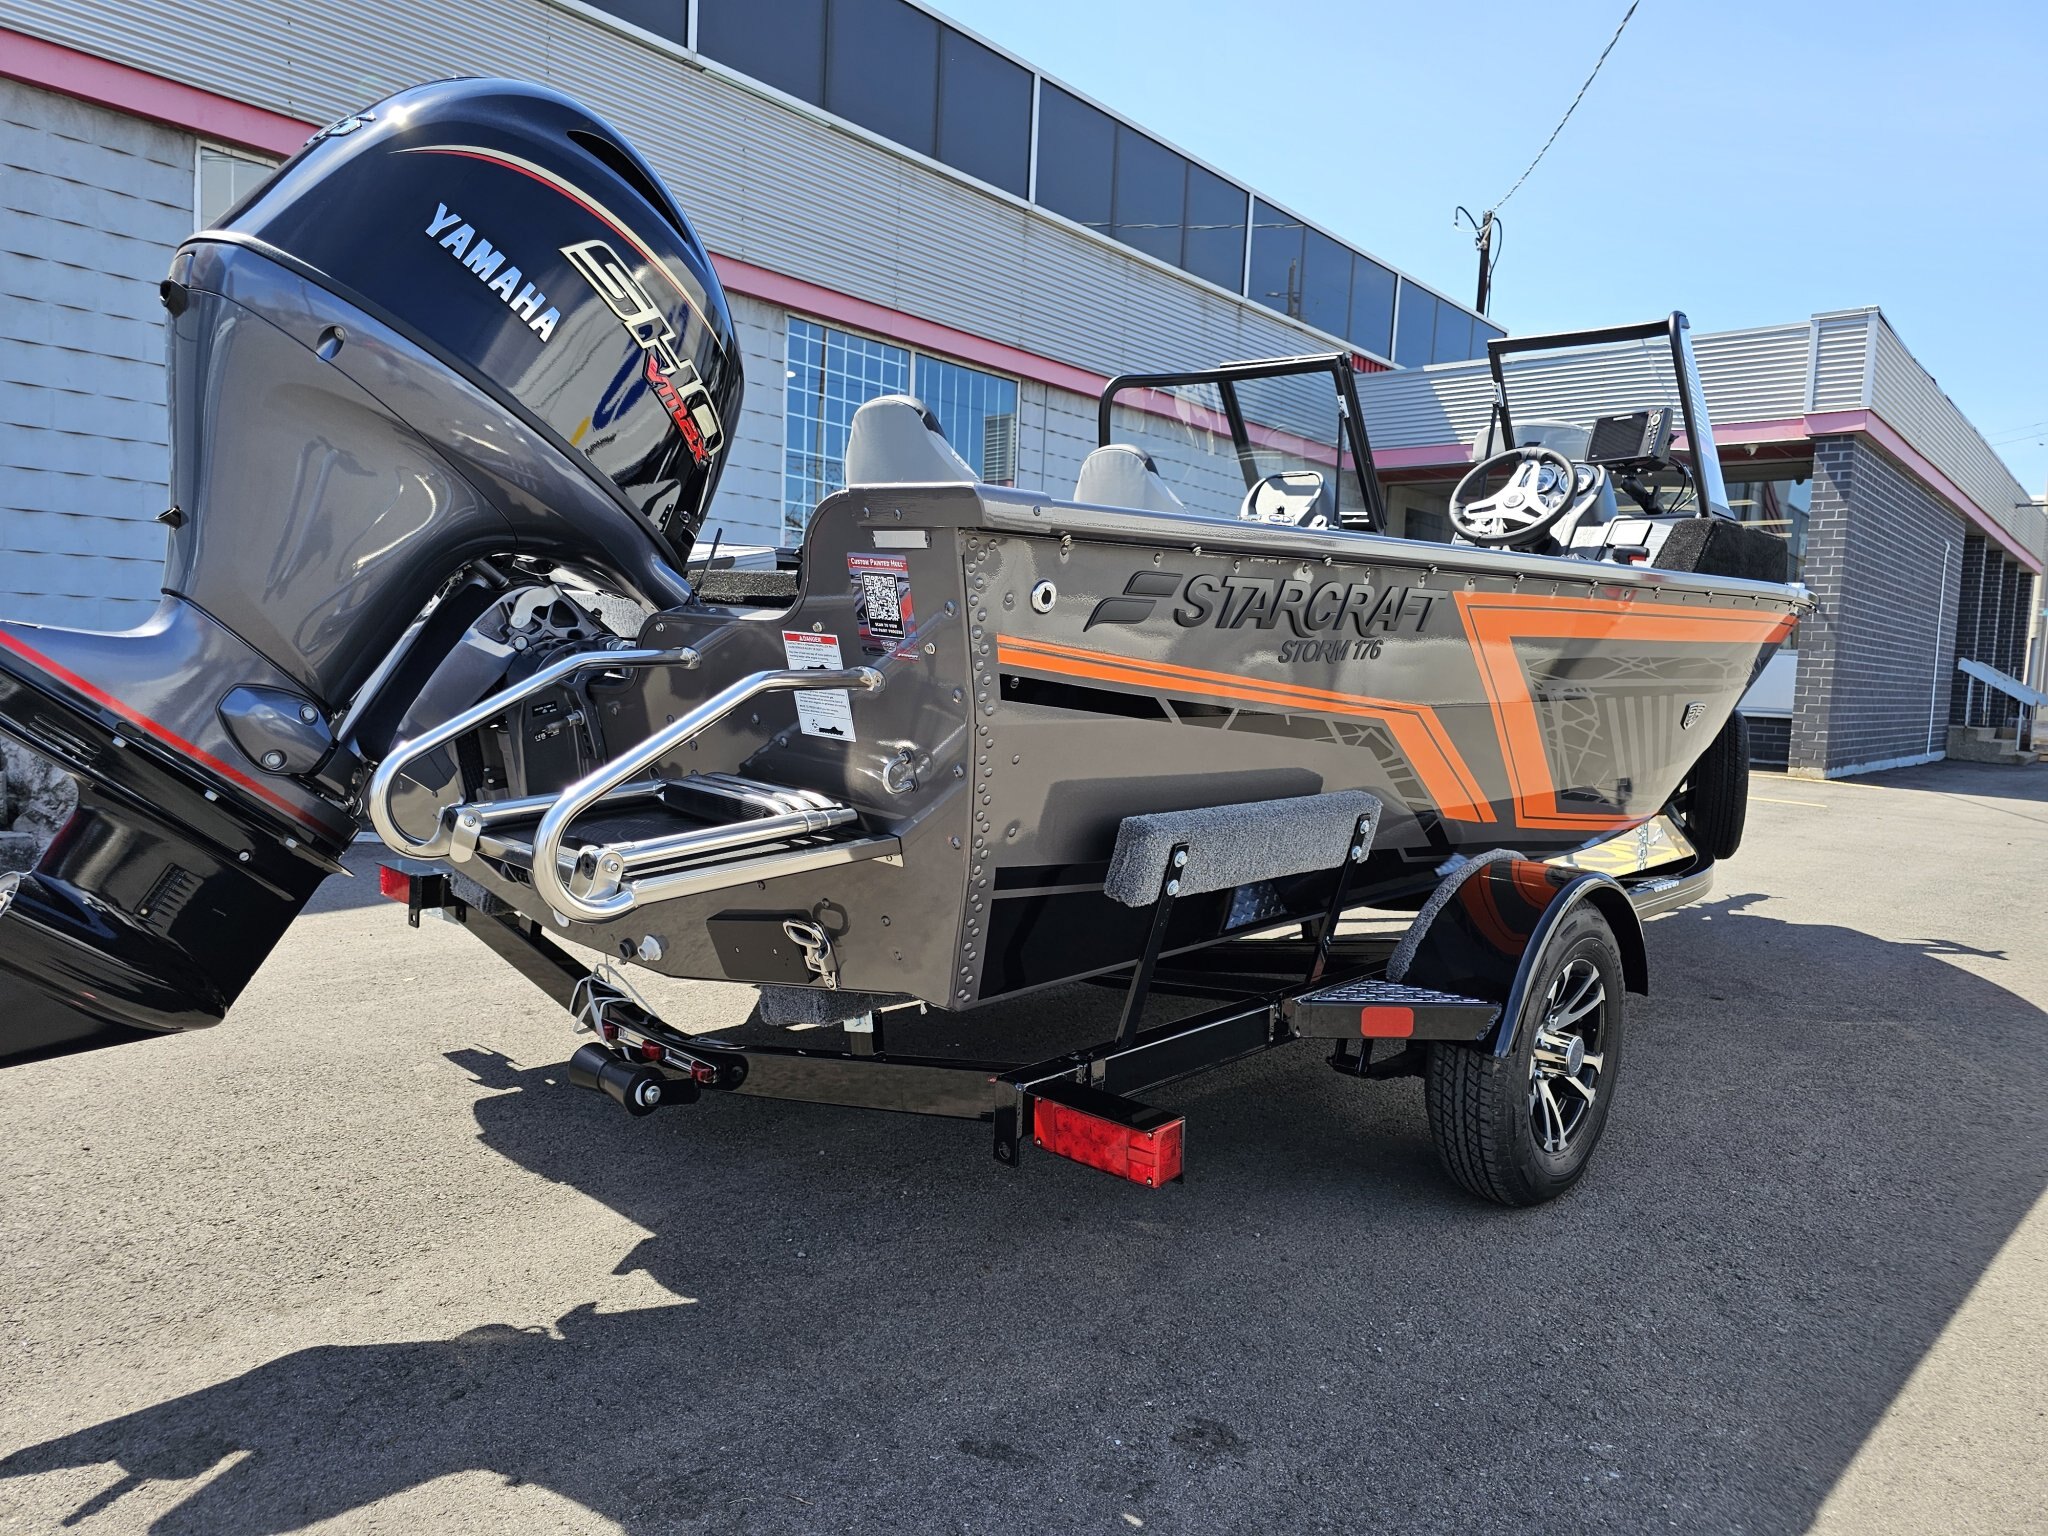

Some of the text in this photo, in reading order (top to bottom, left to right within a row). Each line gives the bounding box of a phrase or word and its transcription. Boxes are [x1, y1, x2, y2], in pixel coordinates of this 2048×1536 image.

[425, 202, 561, 343] YAMAHA
[850, 557, 869, 566] CUSTOM
[869, 558, 890, 567] PAINTED
[890, 559, 904, 568] HULL
[1173, 573, 1449, 639] STARCRAFT
[801, 635, 822, 643] DANGER
[1278, 639, 1384, 664] STORM 176
